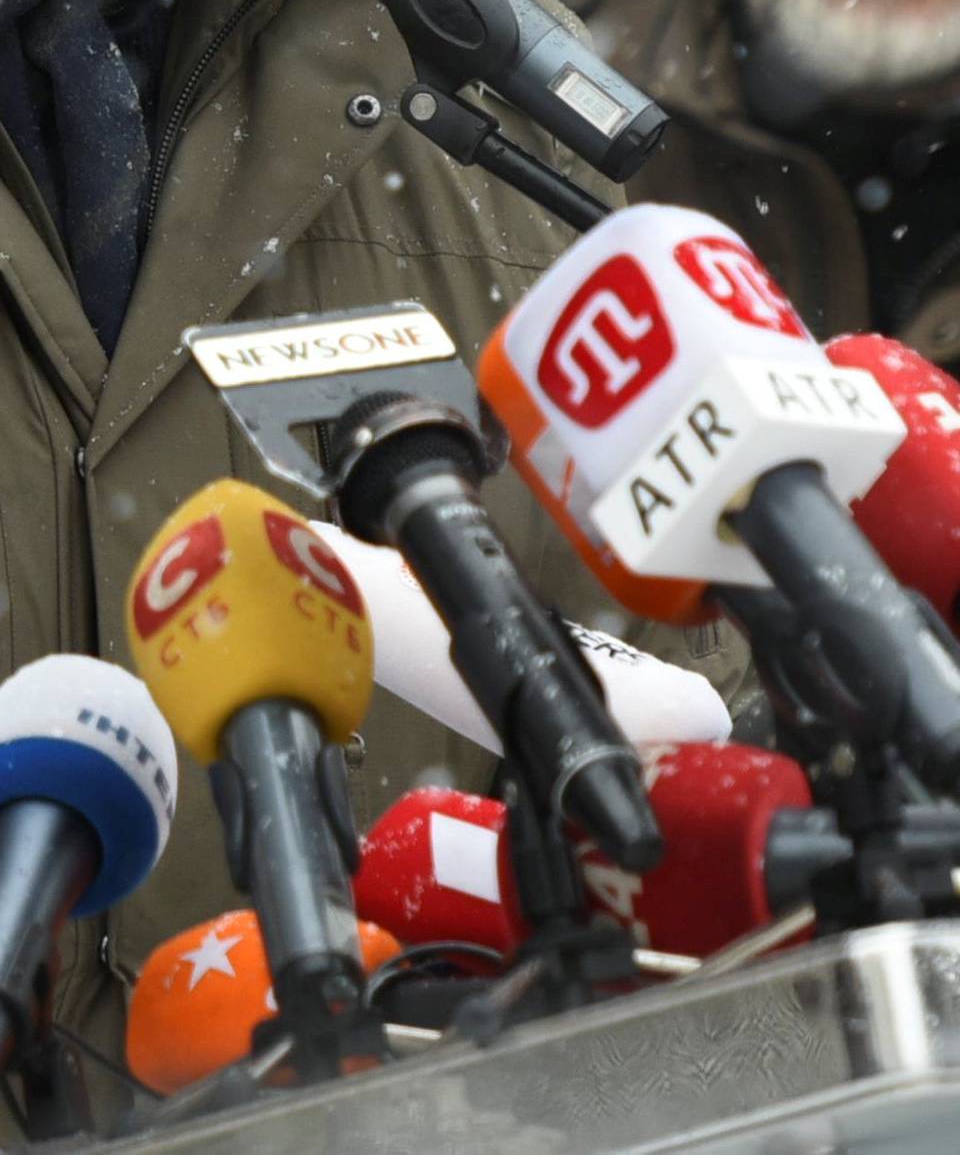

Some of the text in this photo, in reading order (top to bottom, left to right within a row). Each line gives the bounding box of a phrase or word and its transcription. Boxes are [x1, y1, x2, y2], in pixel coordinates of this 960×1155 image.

[216, 326, 427, 370] NEWSONE
[767, 371, 879, 422] ATR
[630, 399, 735, 537] ATR
